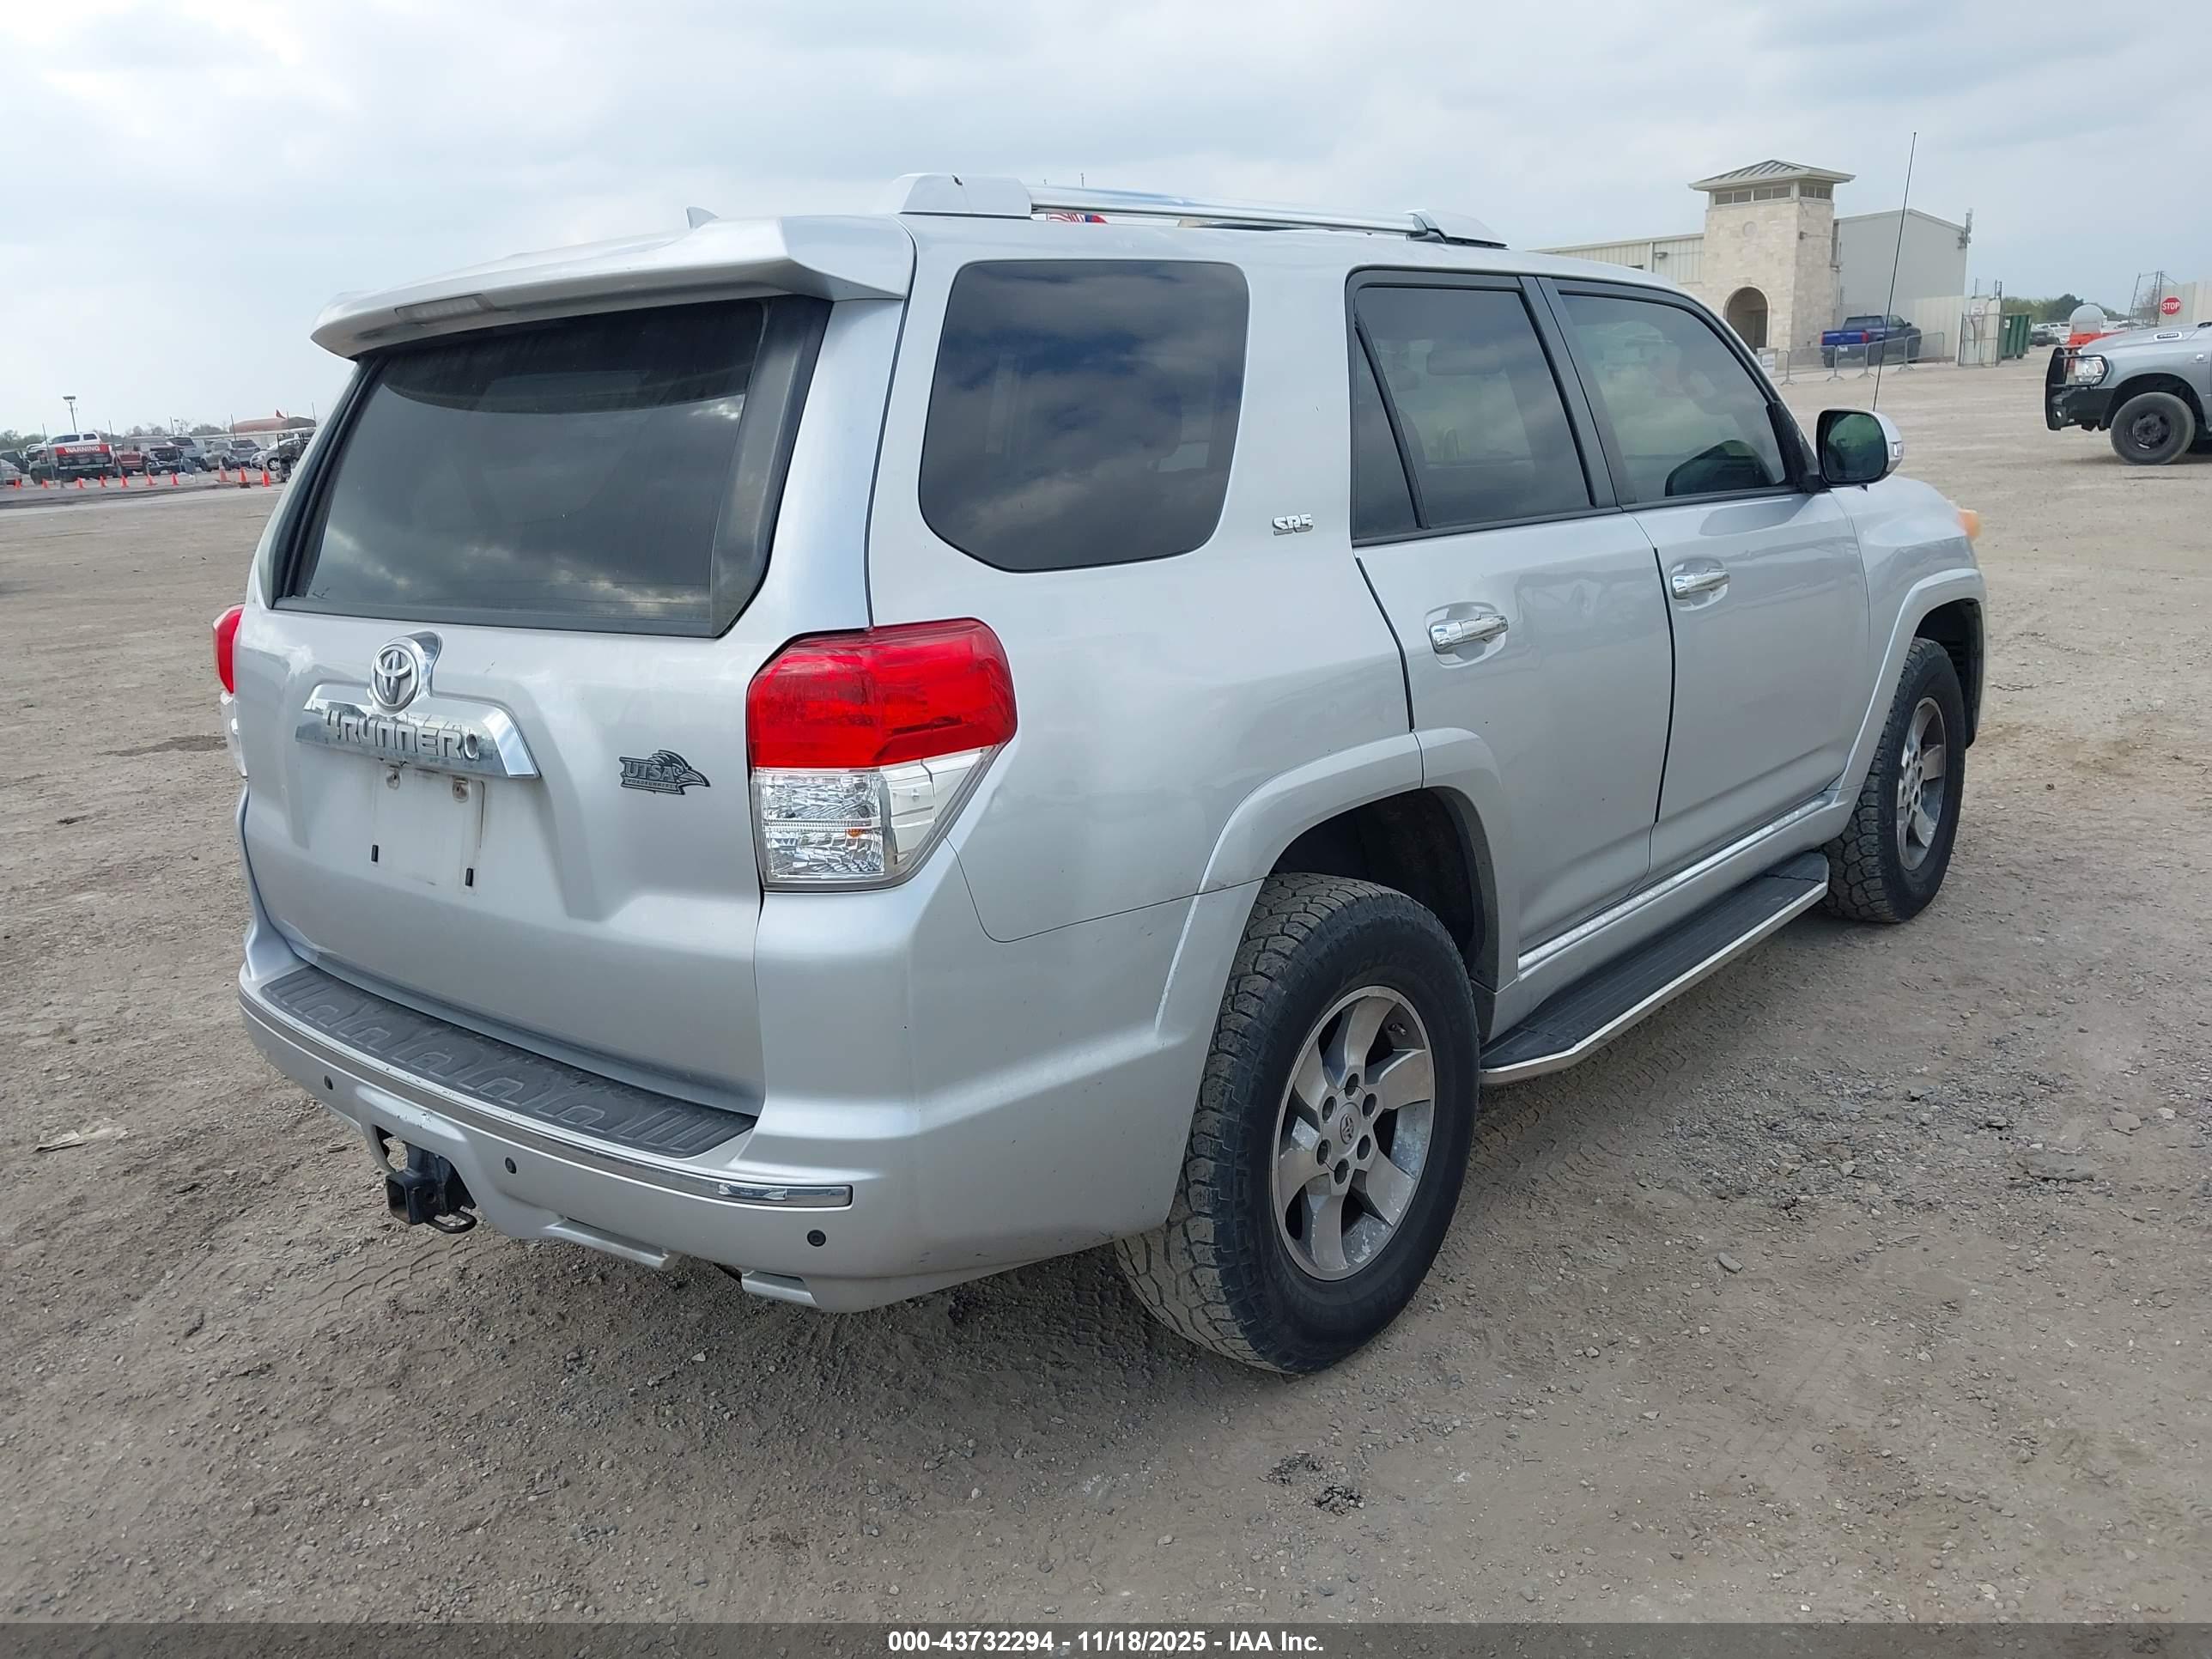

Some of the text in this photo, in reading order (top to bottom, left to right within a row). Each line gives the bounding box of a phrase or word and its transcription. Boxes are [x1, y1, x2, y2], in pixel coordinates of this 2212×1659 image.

[2162, 301, 2180, 310] STOP
[64, 445, 100, 453] WARNING
[625, 761, 675, 782] UTSA
